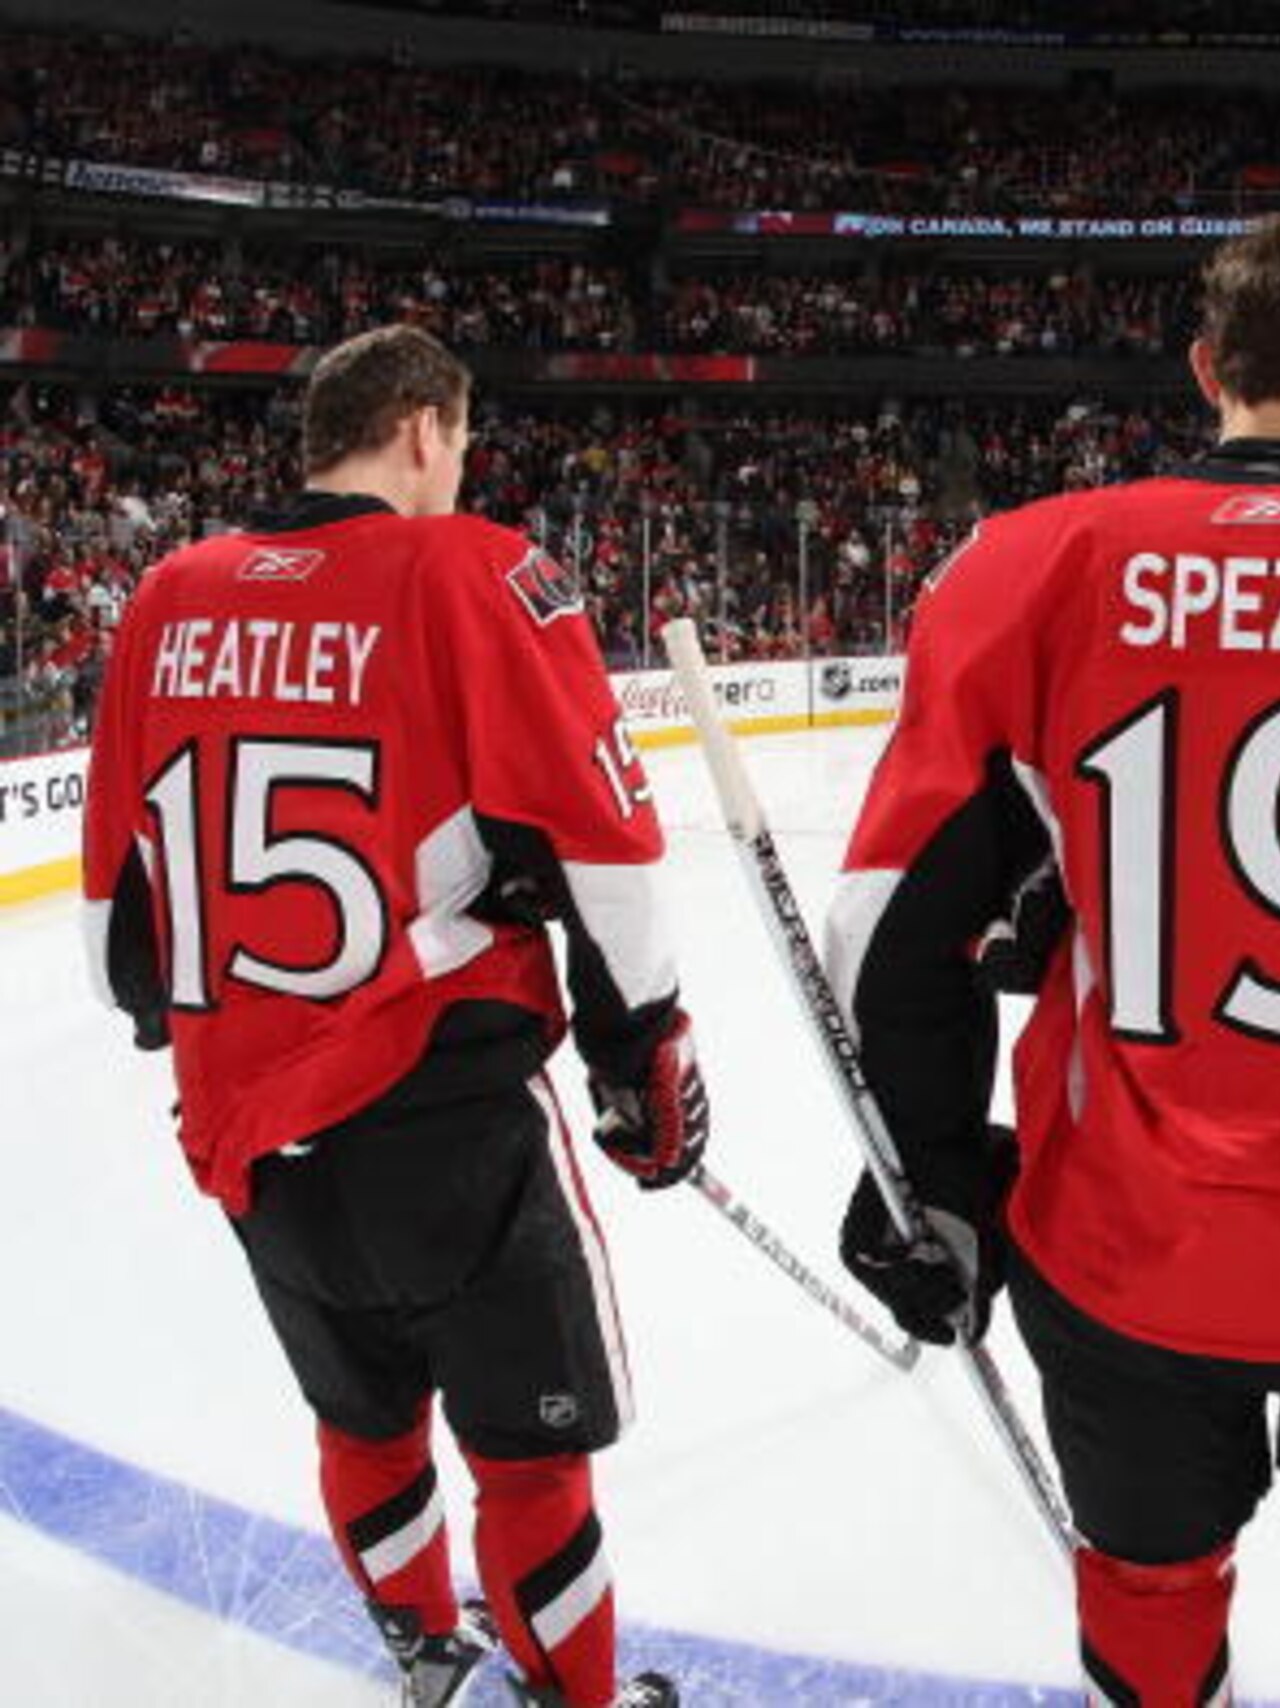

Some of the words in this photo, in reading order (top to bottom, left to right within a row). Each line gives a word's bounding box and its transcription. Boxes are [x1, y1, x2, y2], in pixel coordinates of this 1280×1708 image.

[1057, 219, 1135, 237] STAND
[151, 619, 381, 706] HEATLEY
[143, 734, 387, 1011] 15
